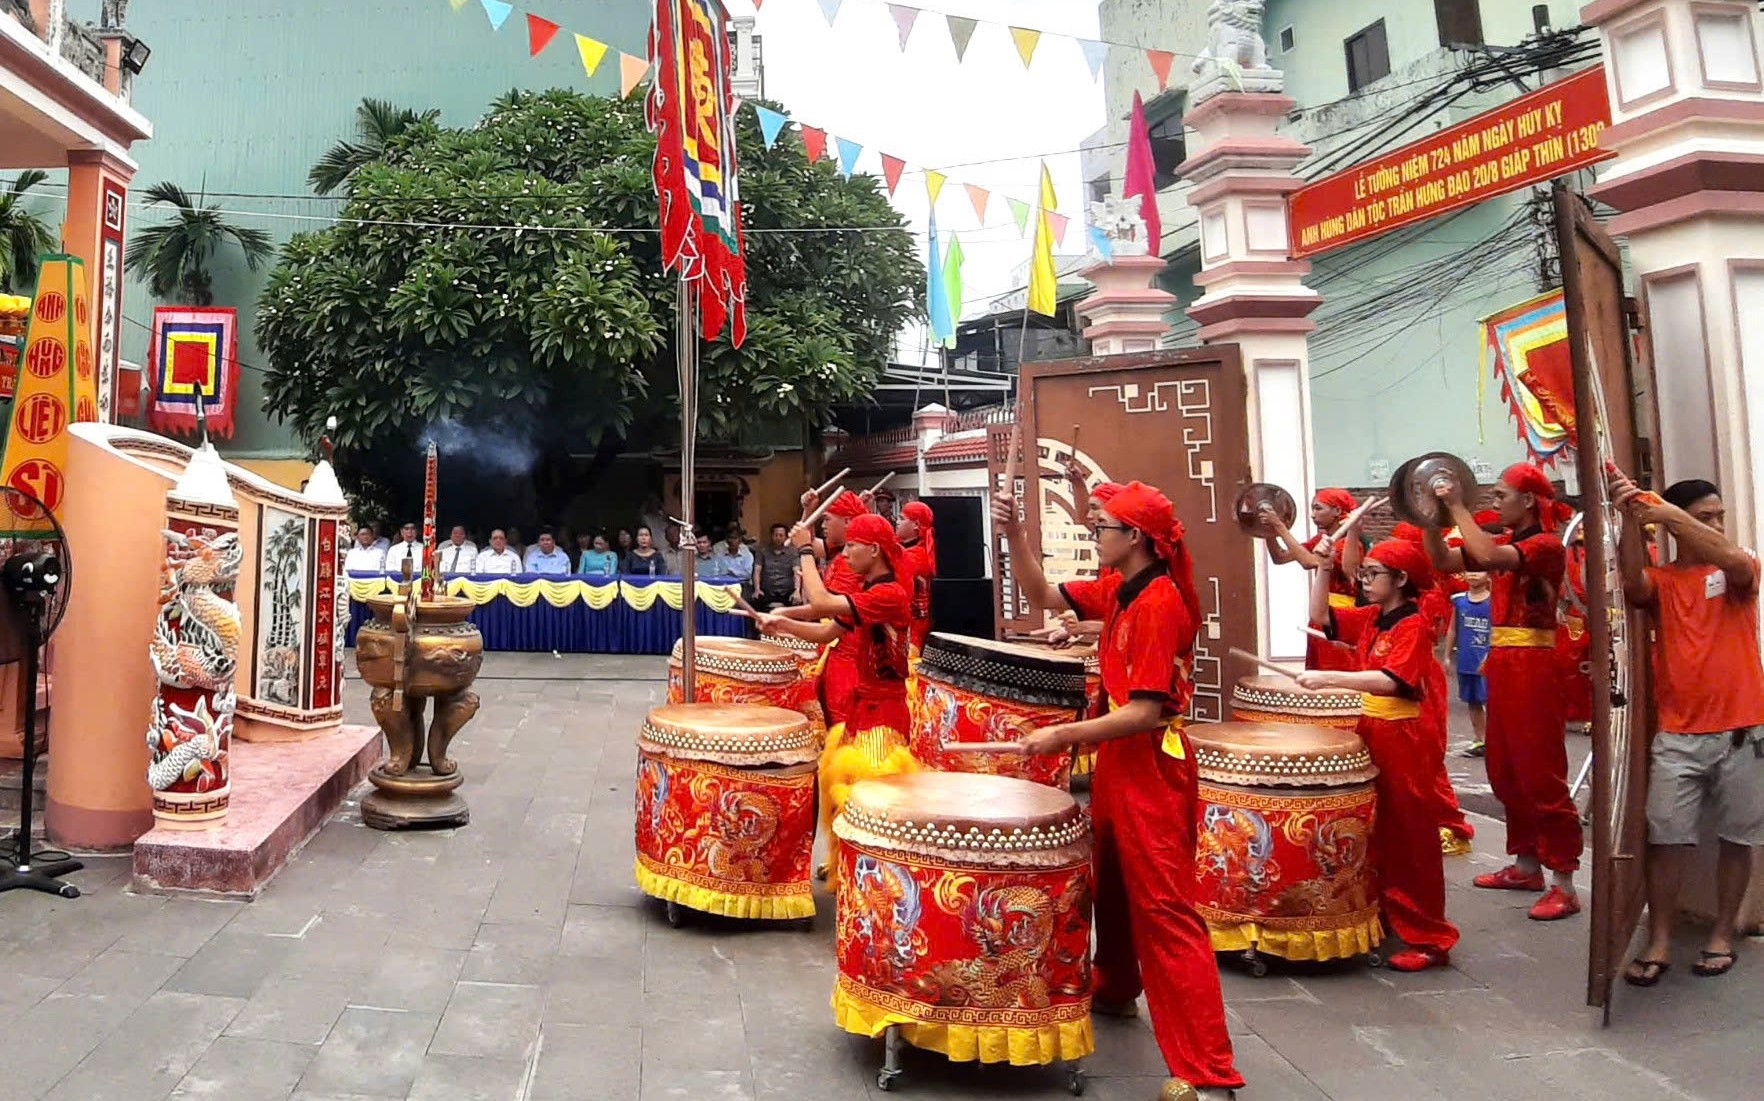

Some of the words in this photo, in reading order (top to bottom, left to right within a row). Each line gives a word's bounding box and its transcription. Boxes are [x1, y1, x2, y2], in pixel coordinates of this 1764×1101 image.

[1301, 224, 1320, 247] ANH
[1320, 215, 1345, 240] HÙNG
[1346, 206, 1366, 232] DÂN
[1366, 198, 1386, 227] TỘC
[1387, 185, 1414, 218] TRẦN
[1415, 179, 1446, 208] HƯNG
[1447, 170, 1471, 200] ĐẠO
[1473, 160, 1499, 190] 20/8
[1501, 146, 1531, 179] GIÁP
[1532, 134, 1564, 168] THÌN
[1354, 171, 1367, 200] LỄ
[1367, 163, 1400, 195] TƯỞNG
[1401, 152, 1429, 183] NIỆM
[1430, 145, 1452, 171] 724
[1452, 132, 1480, 163] NĂM
[1482, 118, 1515, 152] NGÀY
[1517, 106, 1542, 139] HÚY
